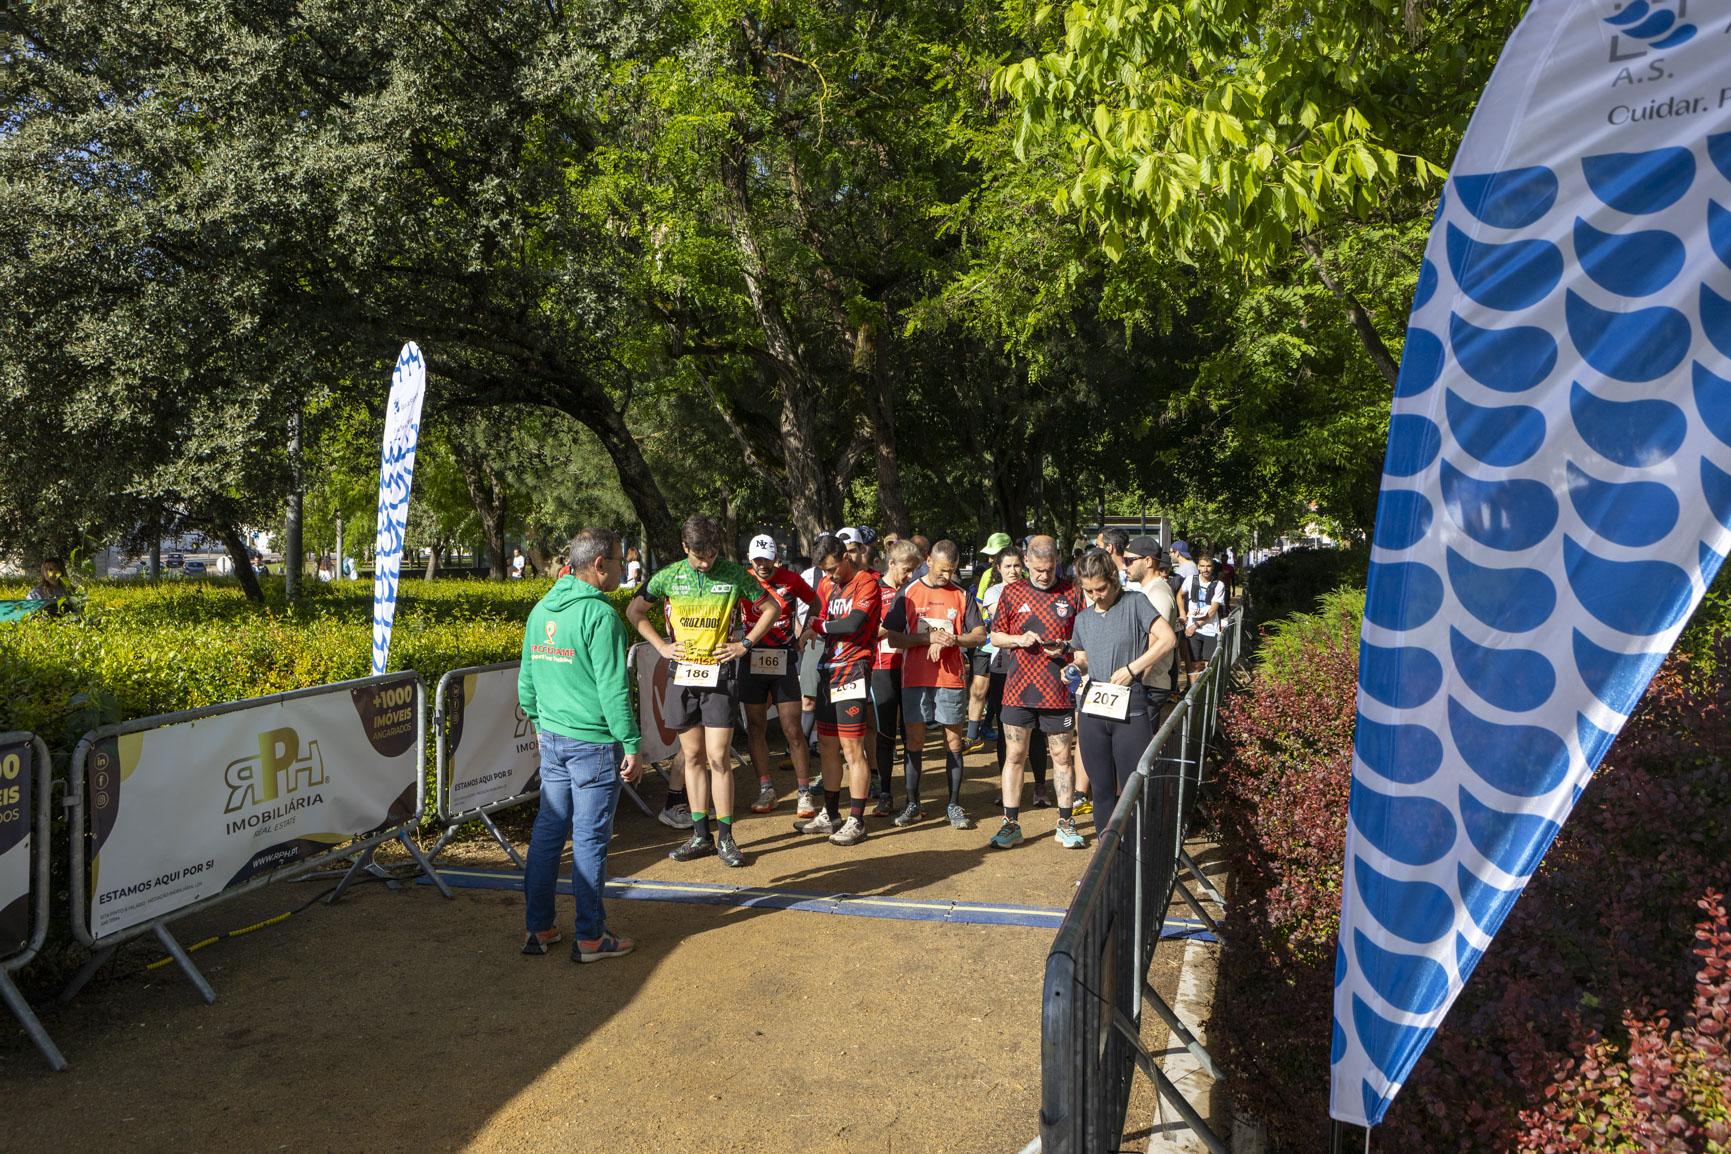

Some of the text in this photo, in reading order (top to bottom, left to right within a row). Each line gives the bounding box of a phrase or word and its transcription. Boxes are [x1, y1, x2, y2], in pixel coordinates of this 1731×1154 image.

[1607, 96, 1708, 125] Cuidar.
[759, 656, 779, 667] 166
[685, 669, 709, 679] 186
[373, 685, 413, 709] +1000
[1093, 691, 1119, 707] 207
[373, 707, 412, 729] IMÓVEIS
[373, 722, 412, 740] ANGARIADOS
[454, 778, 479, 792] ESTAMOS
[226, 793, 324, 836] IMOBILIÁRIA
[99, 859, 215, 905] ESTAMOS AQUI POR SI
